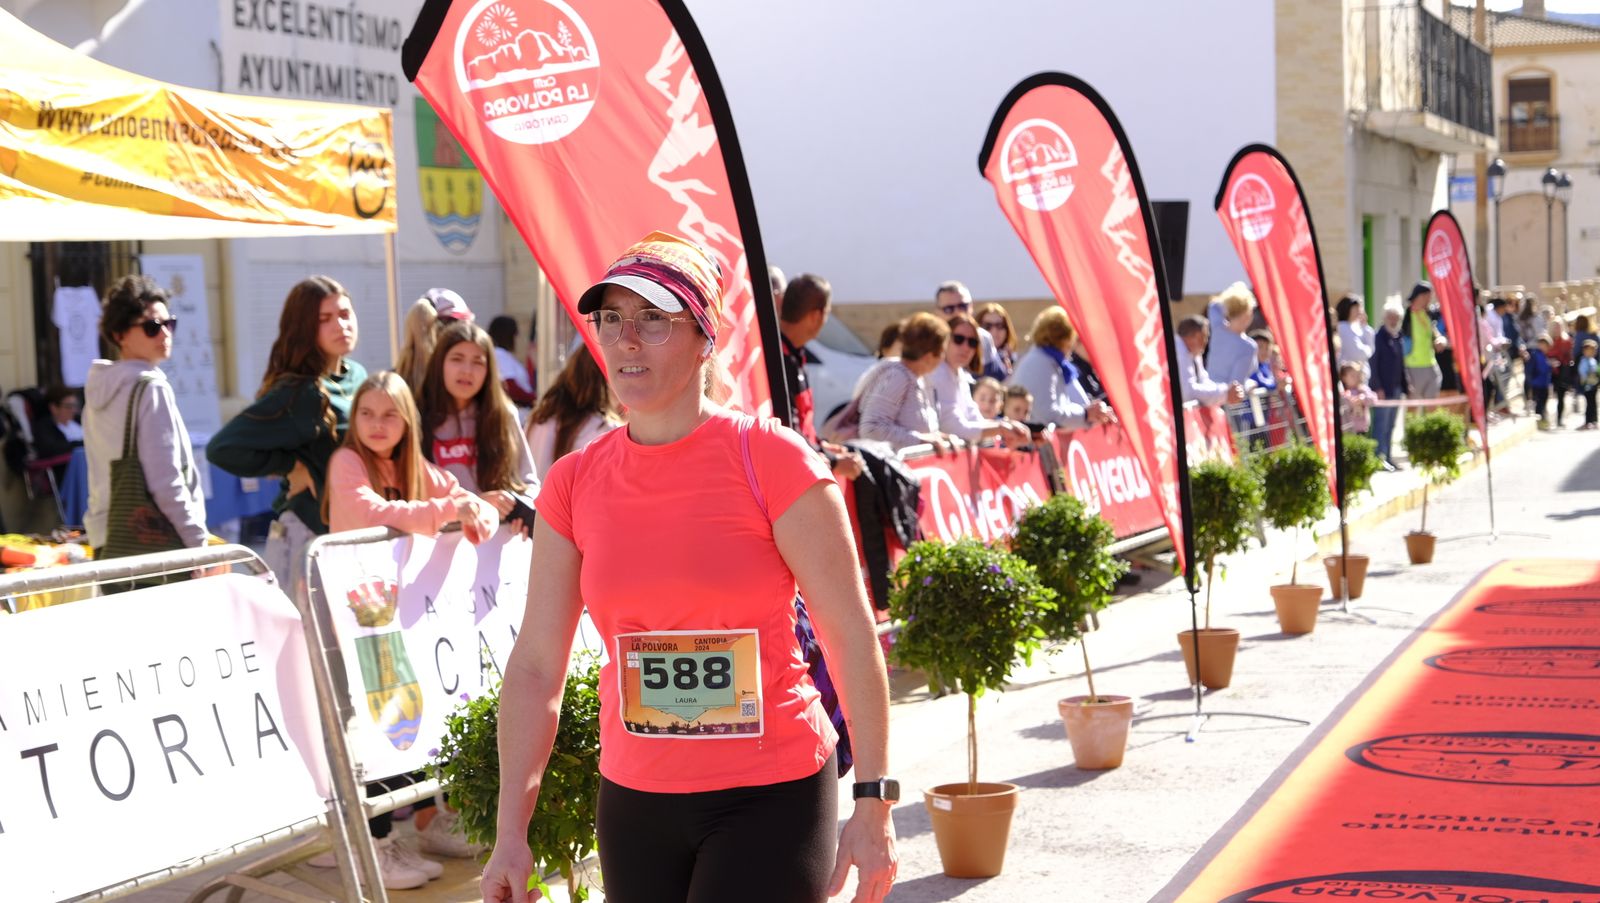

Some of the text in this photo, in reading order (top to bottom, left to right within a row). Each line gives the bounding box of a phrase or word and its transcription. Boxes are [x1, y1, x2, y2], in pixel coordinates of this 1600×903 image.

[239, 54, 400, 106] AYUNTAMIENTO
[631, 642, 679, 652] LA POLVORA
[215, 641, 260, 680] DE
[642, 656, 732, 691] 588
[675, 697, 698, 705] LAURA
[0, 692, 289, 834] TORIA
[1375, 813, 1555, 826] Cantoria
[1324, 880, 1453, 892] Cantoria
